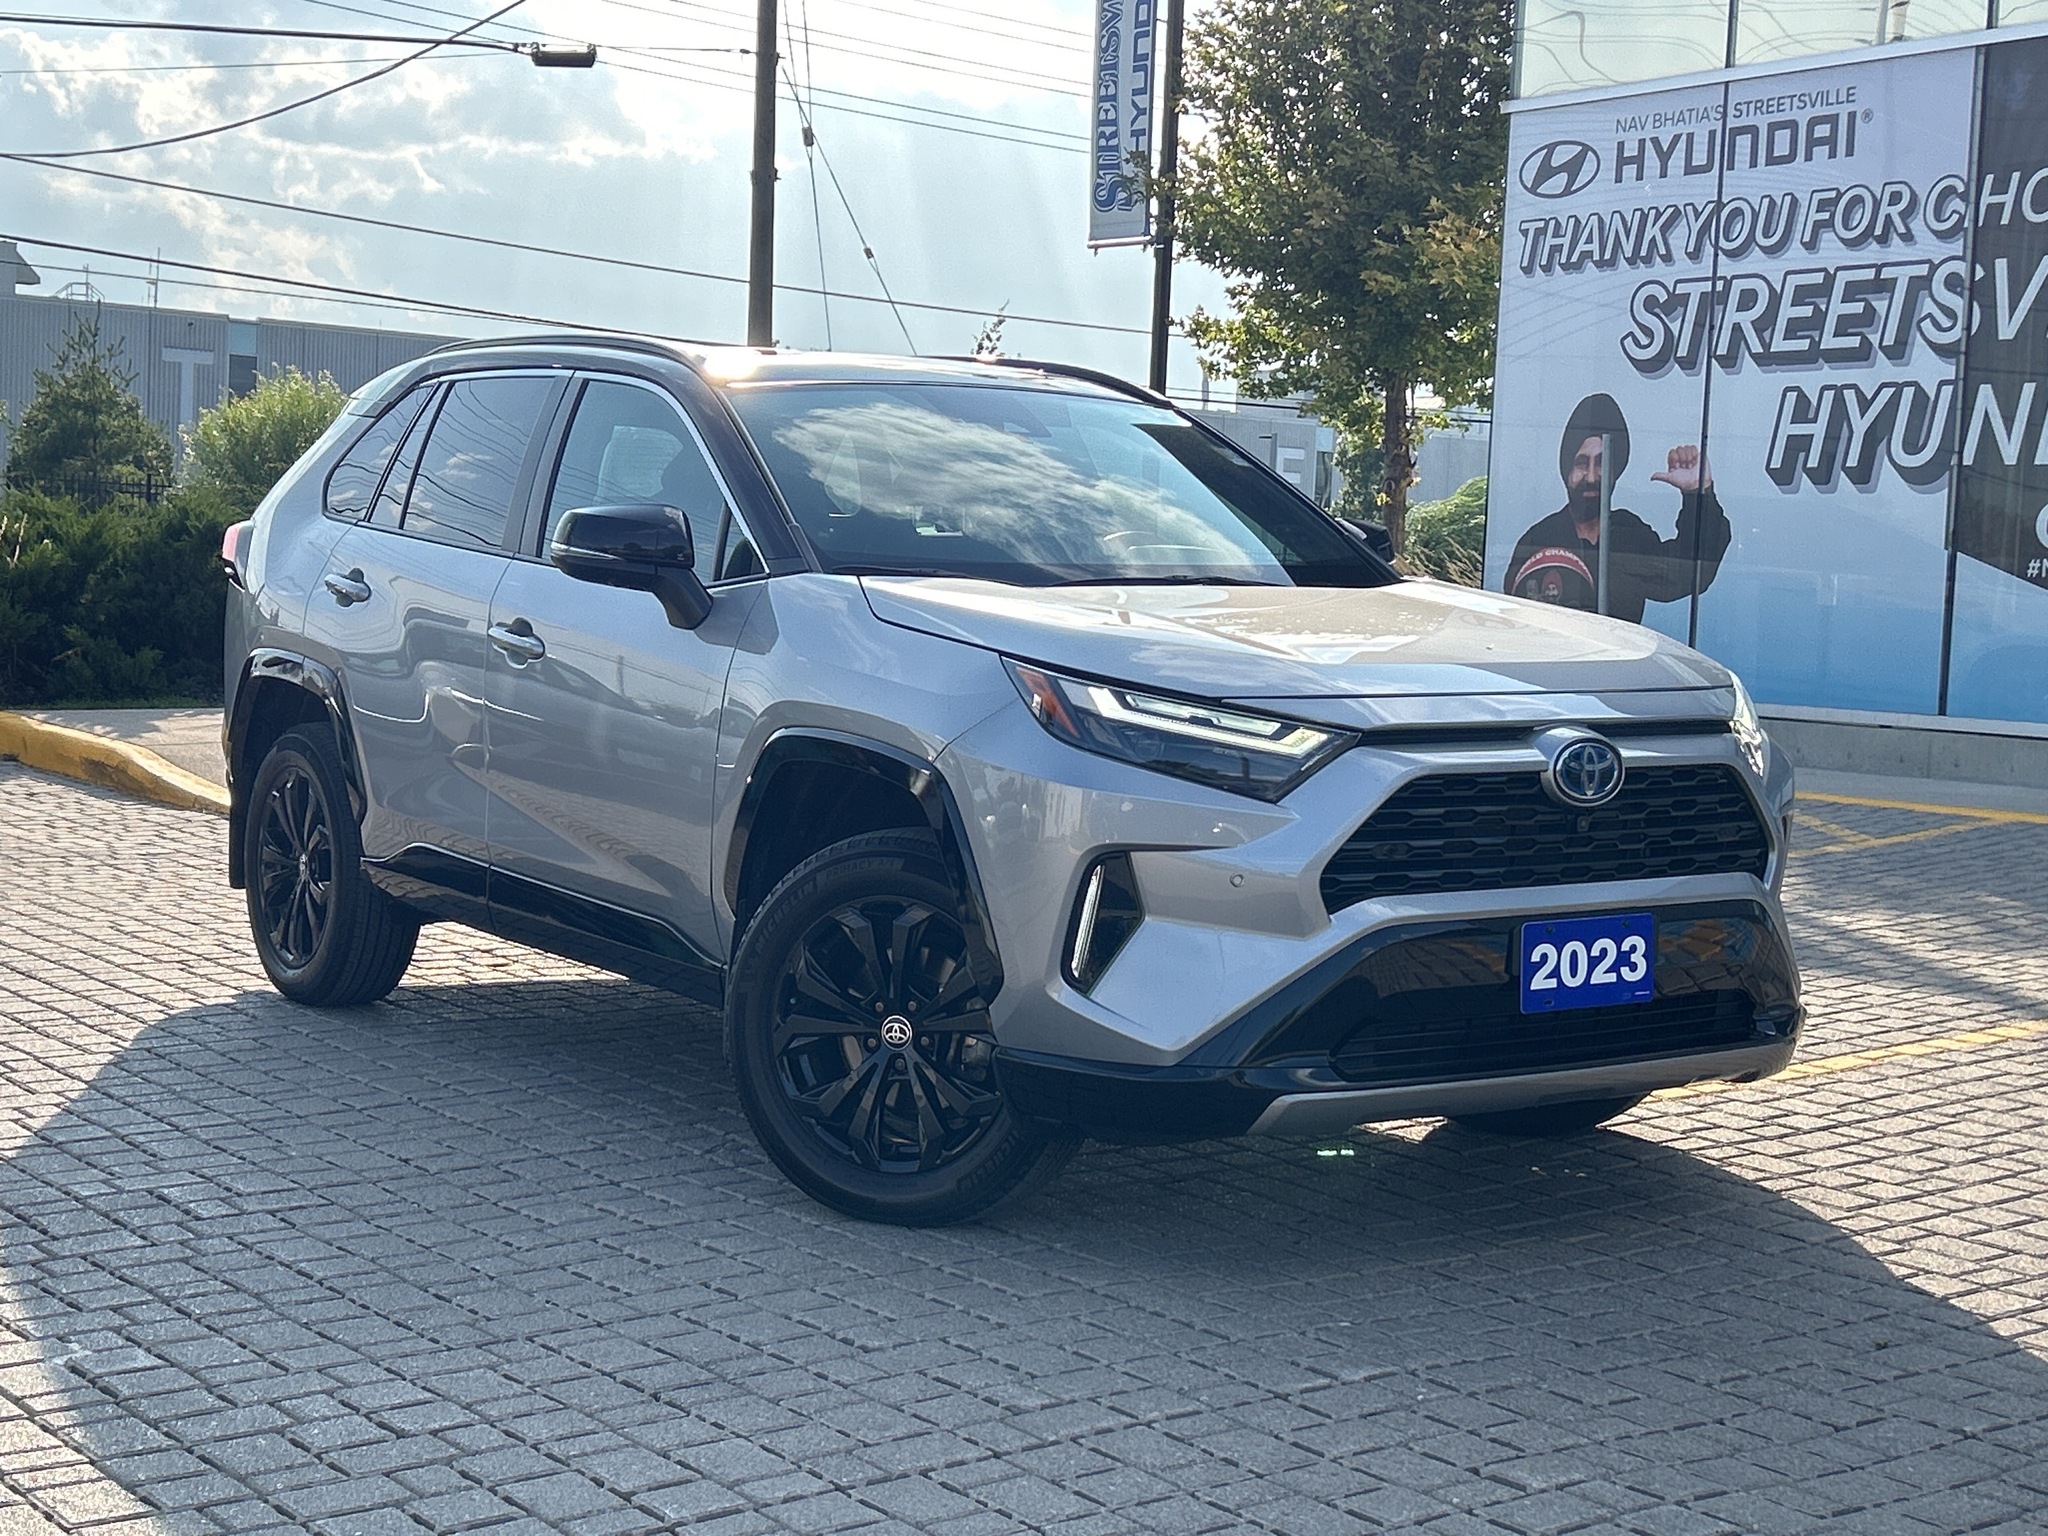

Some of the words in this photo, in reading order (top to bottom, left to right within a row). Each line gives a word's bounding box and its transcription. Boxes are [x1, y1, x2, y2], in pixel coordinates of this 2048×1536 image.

[1615, 114, 1650, 134] NAV
[1652, 104, 1725, 130] BHATIA'S
[1733, 86, 1857, 119] STREETSVILLE
[1519, 205, 1682, 275] THANK
[1684, 192, 1800, 261] YOU
[1801, 180, 1919, 253] FOR
[1530, 935, 1647, 990] 2023
